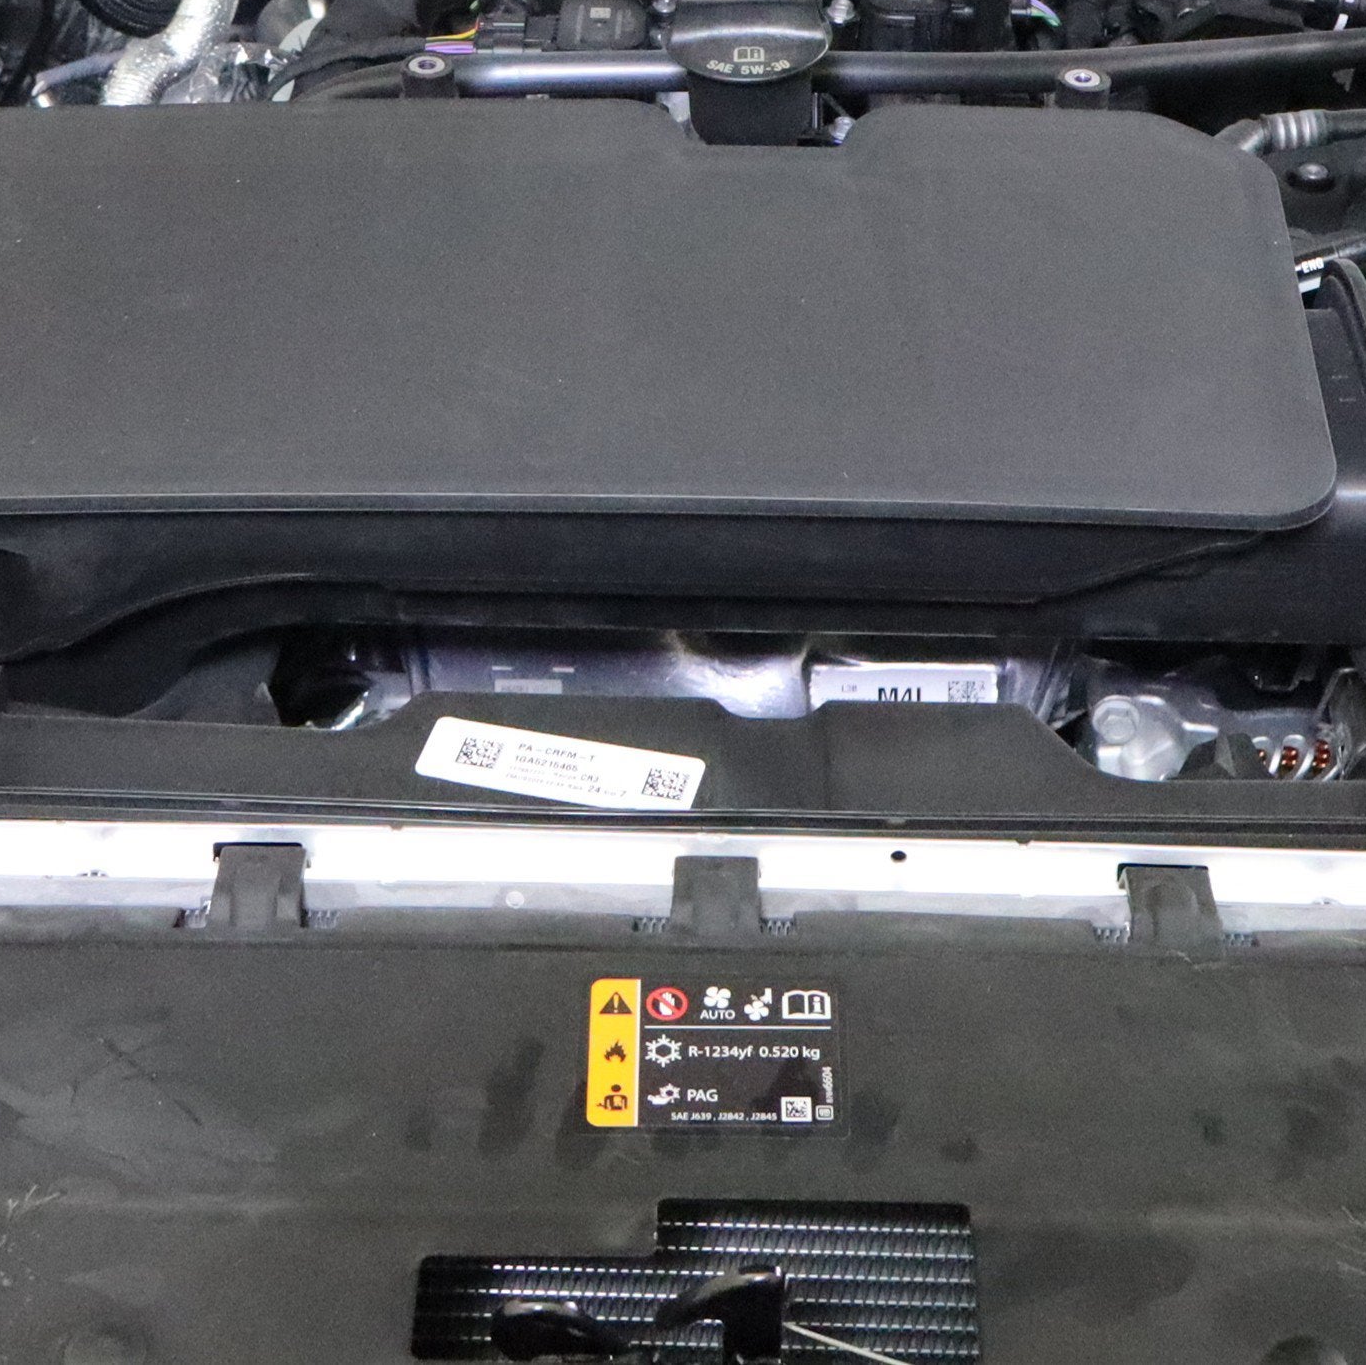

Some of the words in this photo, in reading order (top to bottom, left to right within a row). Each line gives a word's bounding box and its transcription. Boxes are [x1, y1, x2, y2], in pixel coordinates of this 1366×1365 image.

[706, 59, 734, 74] SAE
[741, 59, 791, 75] 5W-30
[700, 1009, 736, 1020] AUTO
[688, 1045, 753, 1060] R-1234yf
[759, 1045, 799, 1058] 0.520
[802, 1045, 820, 1061] kg
[687, 1088, 719, 1102] PAG
[671, 1112, 689, 1121] SAE
